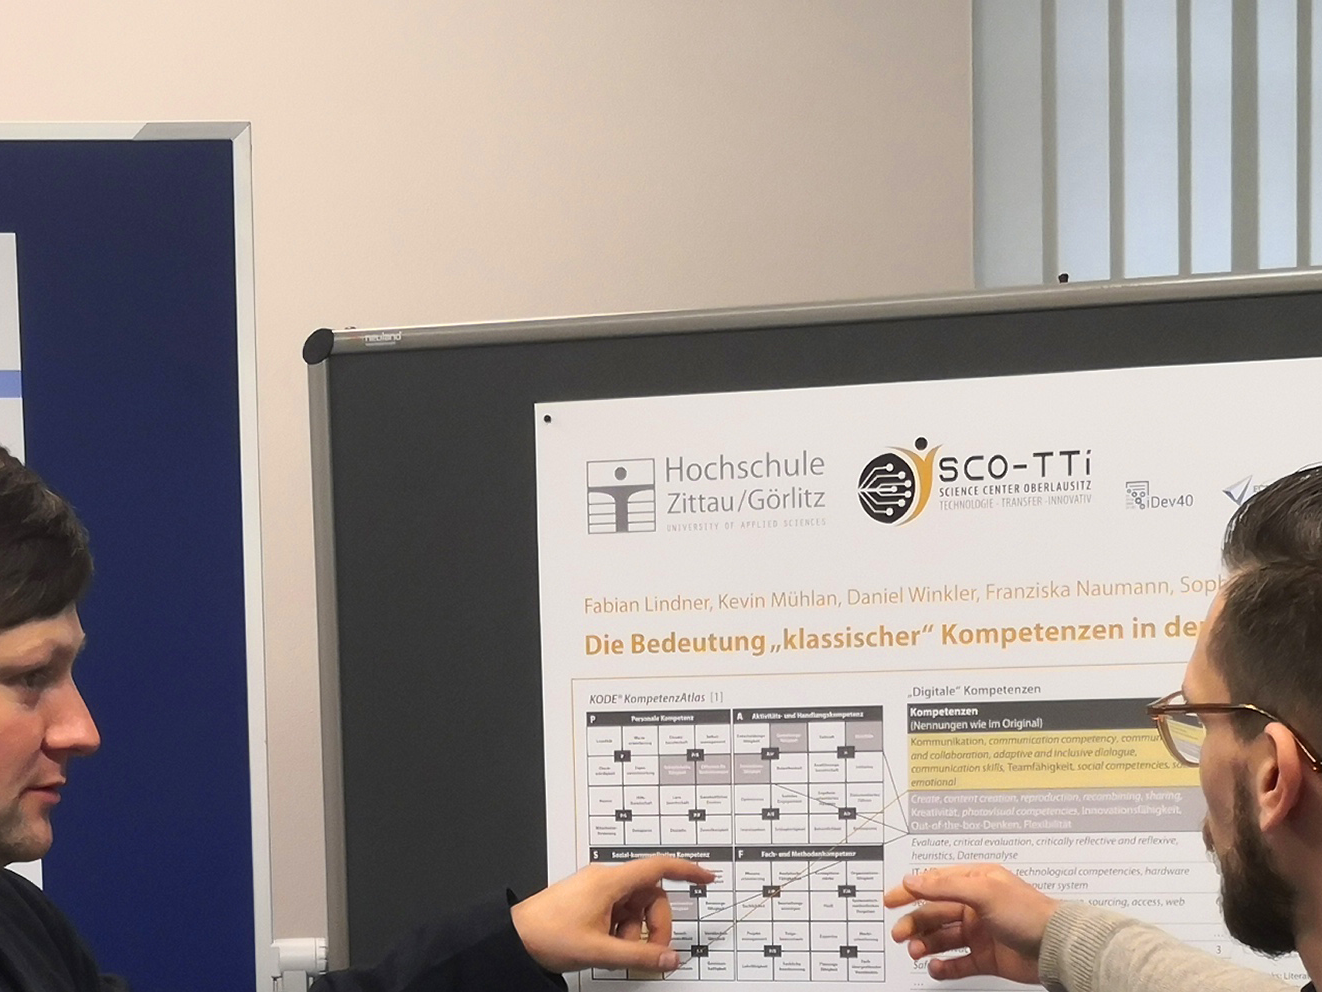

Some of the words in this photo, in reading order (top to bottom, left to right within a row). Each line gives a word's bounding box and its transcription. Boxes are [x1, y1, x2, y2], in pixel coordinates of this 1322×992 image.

[666, 450, 825, 482] Hochschule
[939, 449, 1092, 482] SCO-TTi
[939, 486, 978, 497] SCIENCE
[983, 484, 1020, 495] CENTER
[1024, 480, 1092, 493] OBERLAUSITZ
[667, 487, 826, 514] Zittau/Görlitz
[939, 498, 993, 510] TECHNOLOGIE
[1002, 497, 1042, 508] TRANSFER
[1147, 494, 1194, 508] iDev40
[667, 523, 719, 532] UNIVERSITY
[725, 522, 734, 530] OF
[740, 520, 778, 529] APPLIED
[784, 518, 826, 527] SCIENCES
[585, 596, 639, 614] Fabian
[645, 594, 714, 612] Lindner,
[718, 592, 766, 609] Kevin
[770, 590, 842, 608] Mühlan,
[847, 587, 904, 605] Daniel
[908, 584, 980, 603] Winkler,
[986, 581, 1071, 600] Franziska
[1077, 579, 1174, 597] Naumann,
[585, 634, 624, 656] Die
[631, 631, 766, 656] Bedeutung
[770, 625, 934, 654] „klassischer“
[941, 622, 1124, 648] Kompetenzen
[1133, 617, 1156, 639] in
[964, 685, 1041, 697] Kompetenzen
[624, 692, 705, 704] KompetenzAtlas
[710, 692, 723, 703] [1]
[590, 716, 596, 724] P
[631, 714, 659, 722] Personale
[661, 714, 694, 722] Kompetenz
[737, 712, 743, 720] A
[910, 708, 978, 718] Kompetenzen
[910, 720, 968, 731] (Nennungen
[970, 720, 986, 728] wie
[989, 720, 1001, 728] im
[1002, 718, 1043, 729] Original)
[911, 737, 986, 747] Kommunikation,
[989, 736, 1059, 746] communication
[593, 850, 599, 859] S
[738, 850, 743, 858] F
